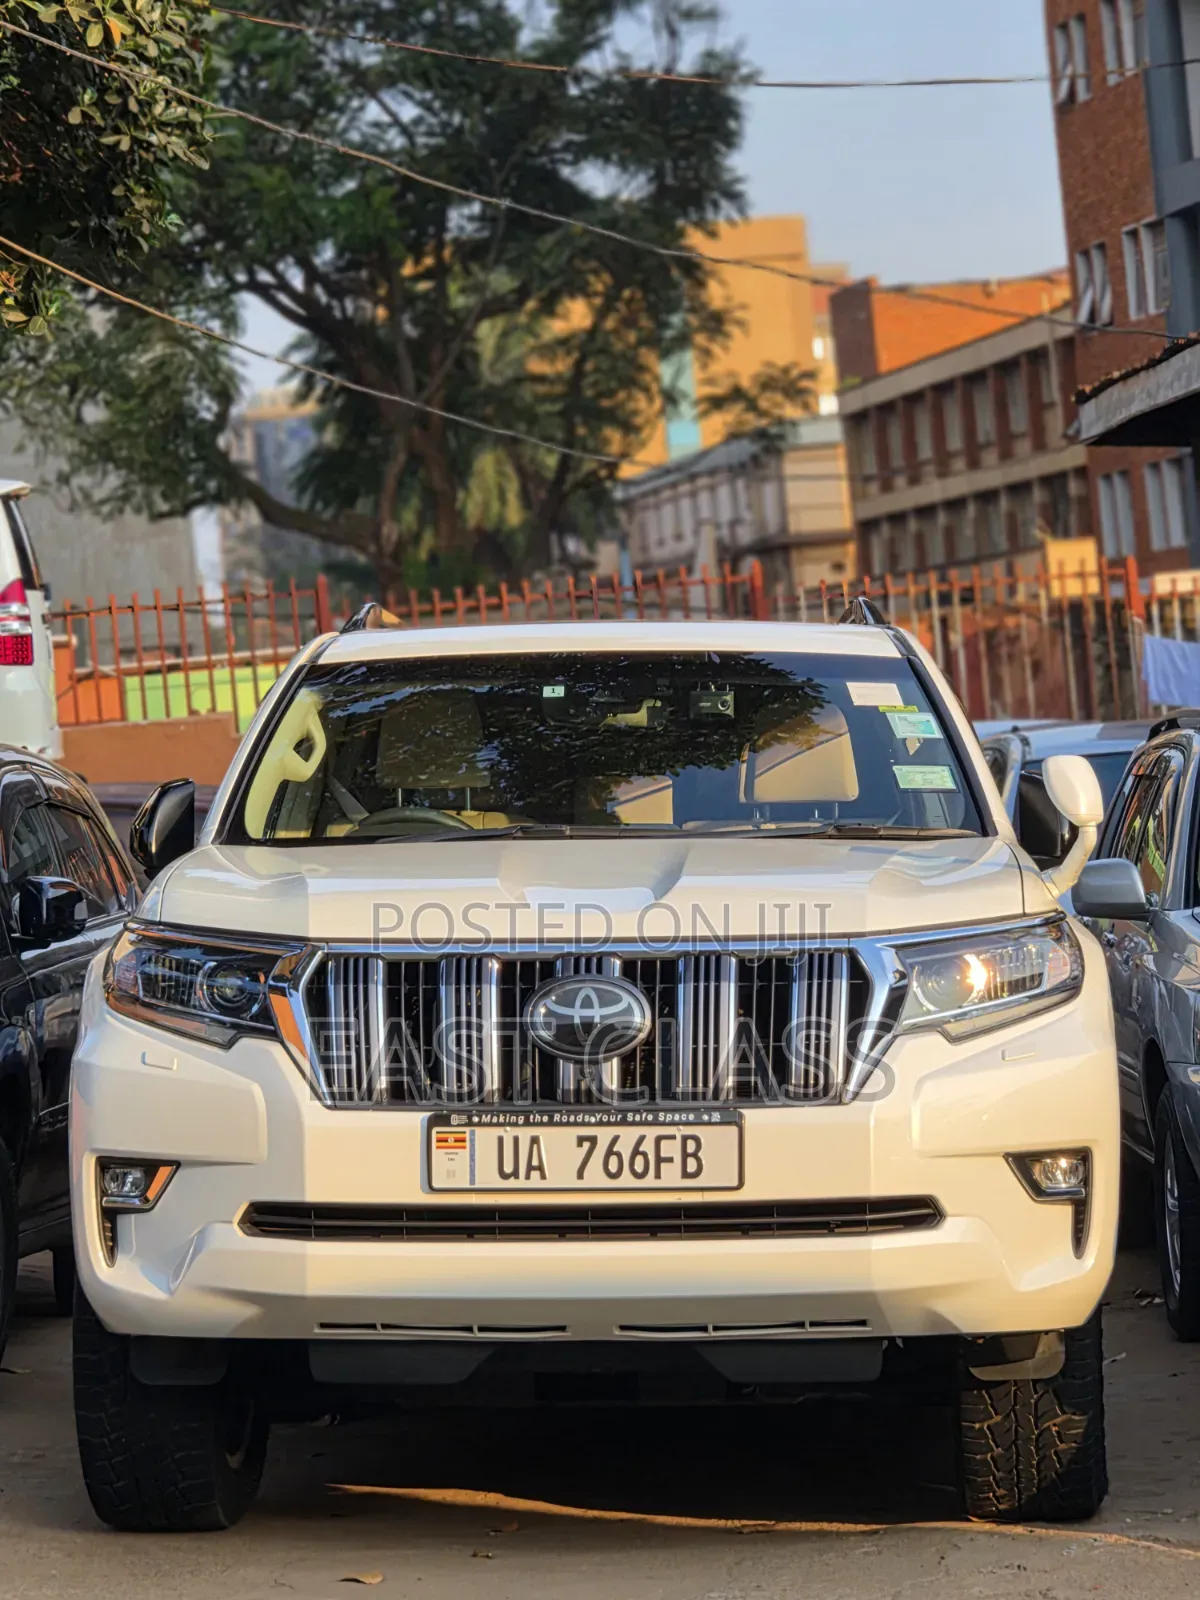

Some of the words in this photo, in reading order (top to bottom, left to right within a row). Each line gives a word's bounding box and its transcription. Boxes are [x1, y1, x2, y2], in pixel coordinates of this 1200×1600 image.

[481, 1113, 525, 1125] Making
[529, 1113, 548, 1123] the
[626, 1112, 653, 1122] Safe
[658, 1112, 695, 1123] Space
[497, 1134, 547, 1180] UA
[576, 1133, 704, 1180] 766FB
